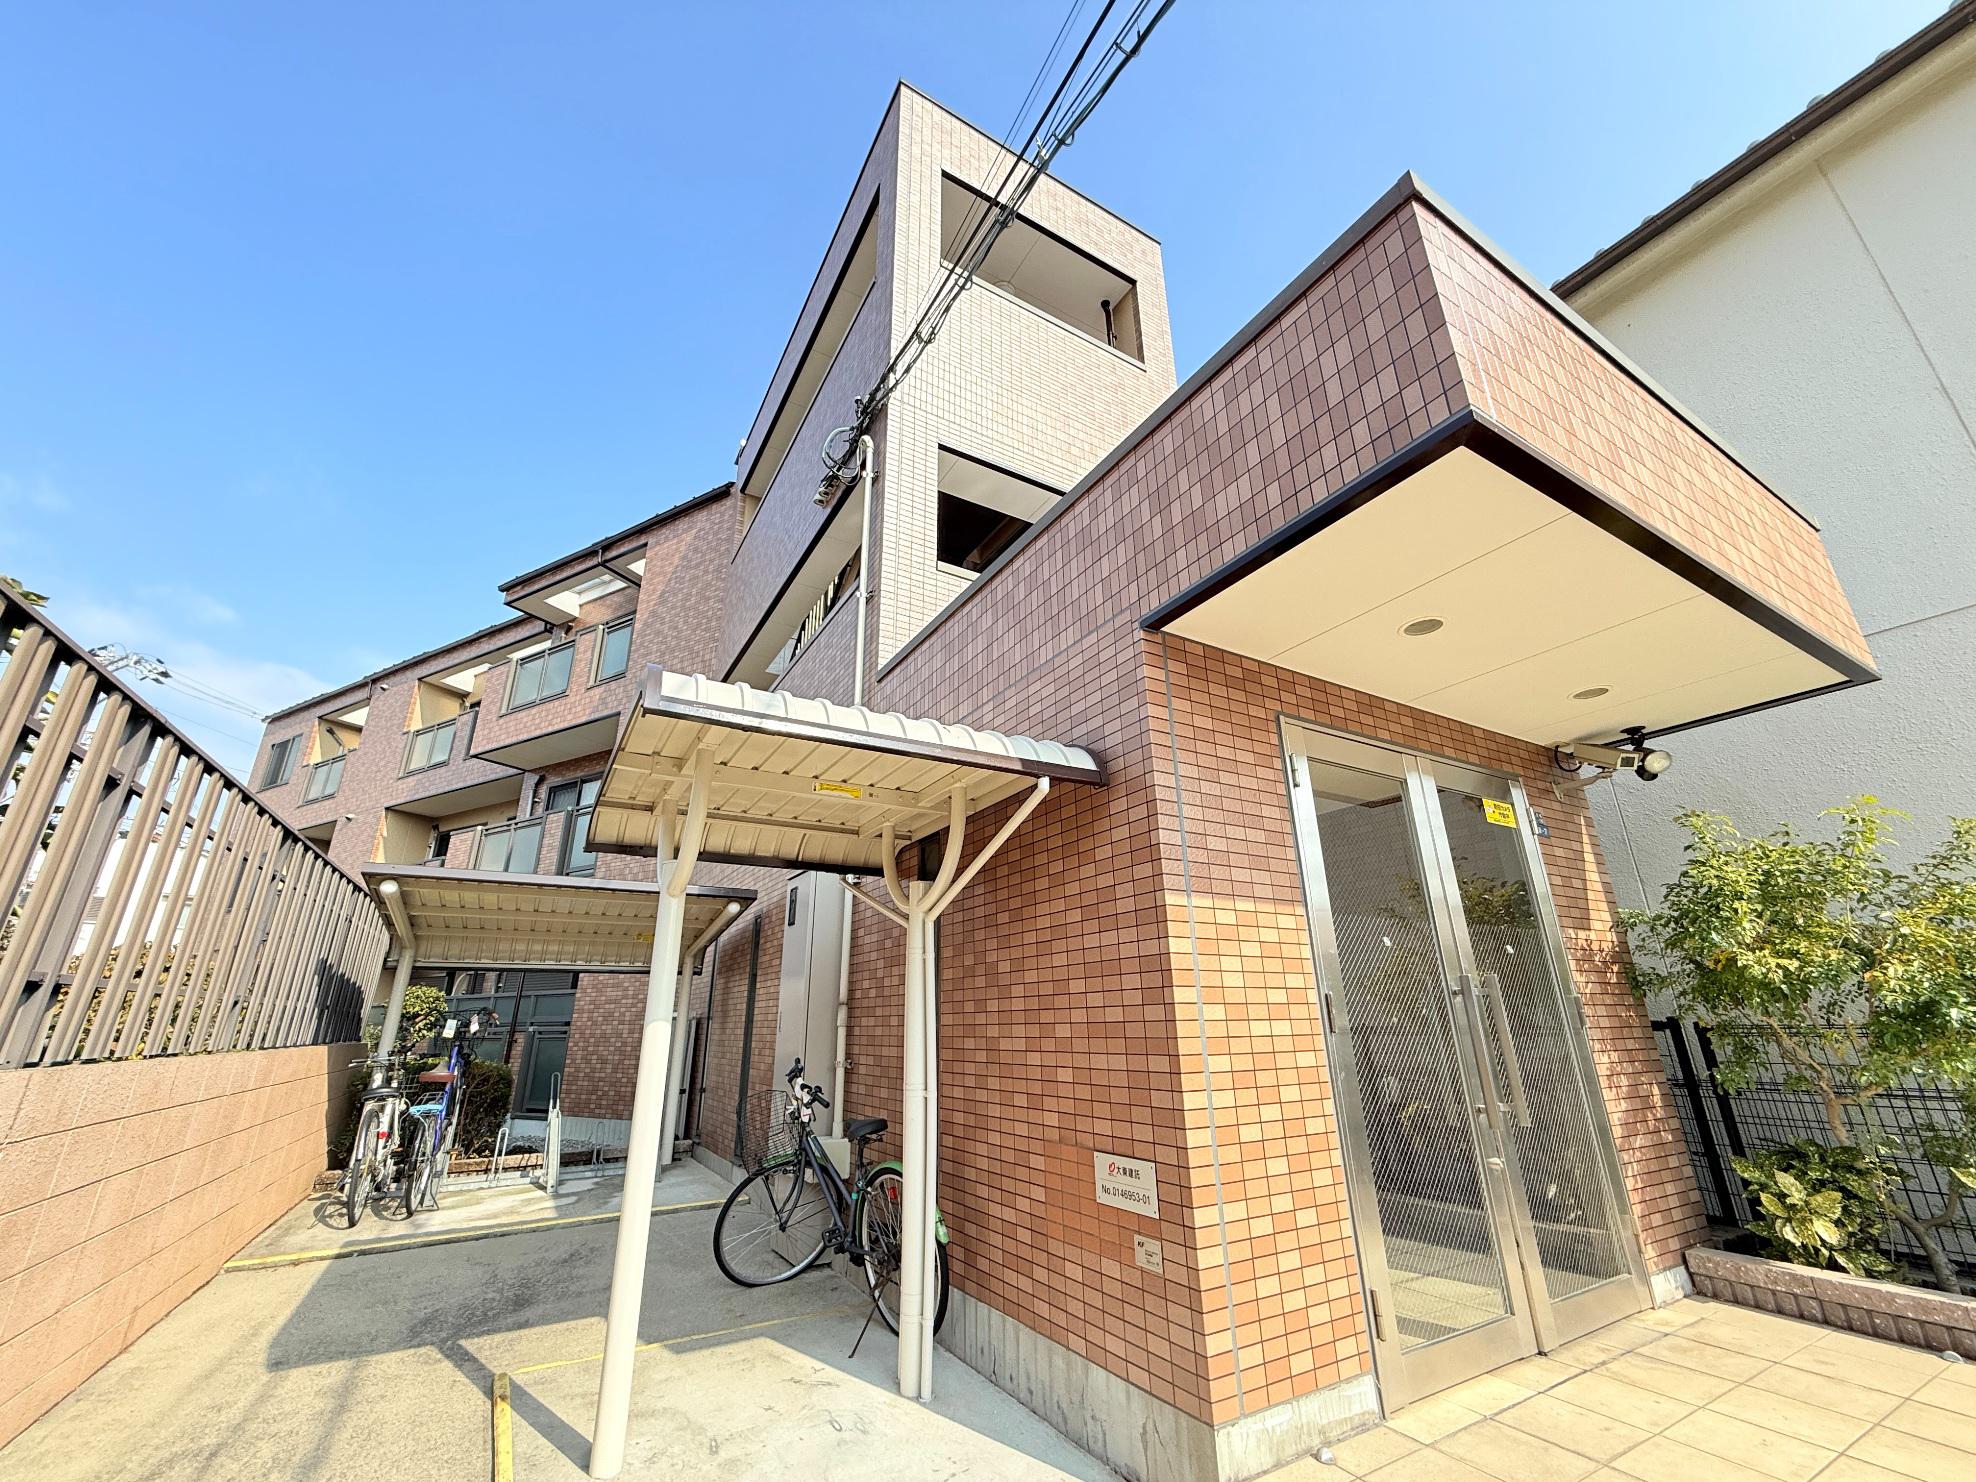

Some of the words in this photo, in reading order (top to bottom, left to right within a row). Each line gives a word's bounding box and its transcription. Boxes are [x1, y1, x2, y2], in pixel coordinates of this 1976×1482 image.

[1116, 1166, 1140, 1180] 大東建託
[1101, 1184, 1151, 1205] No.0146953-01
